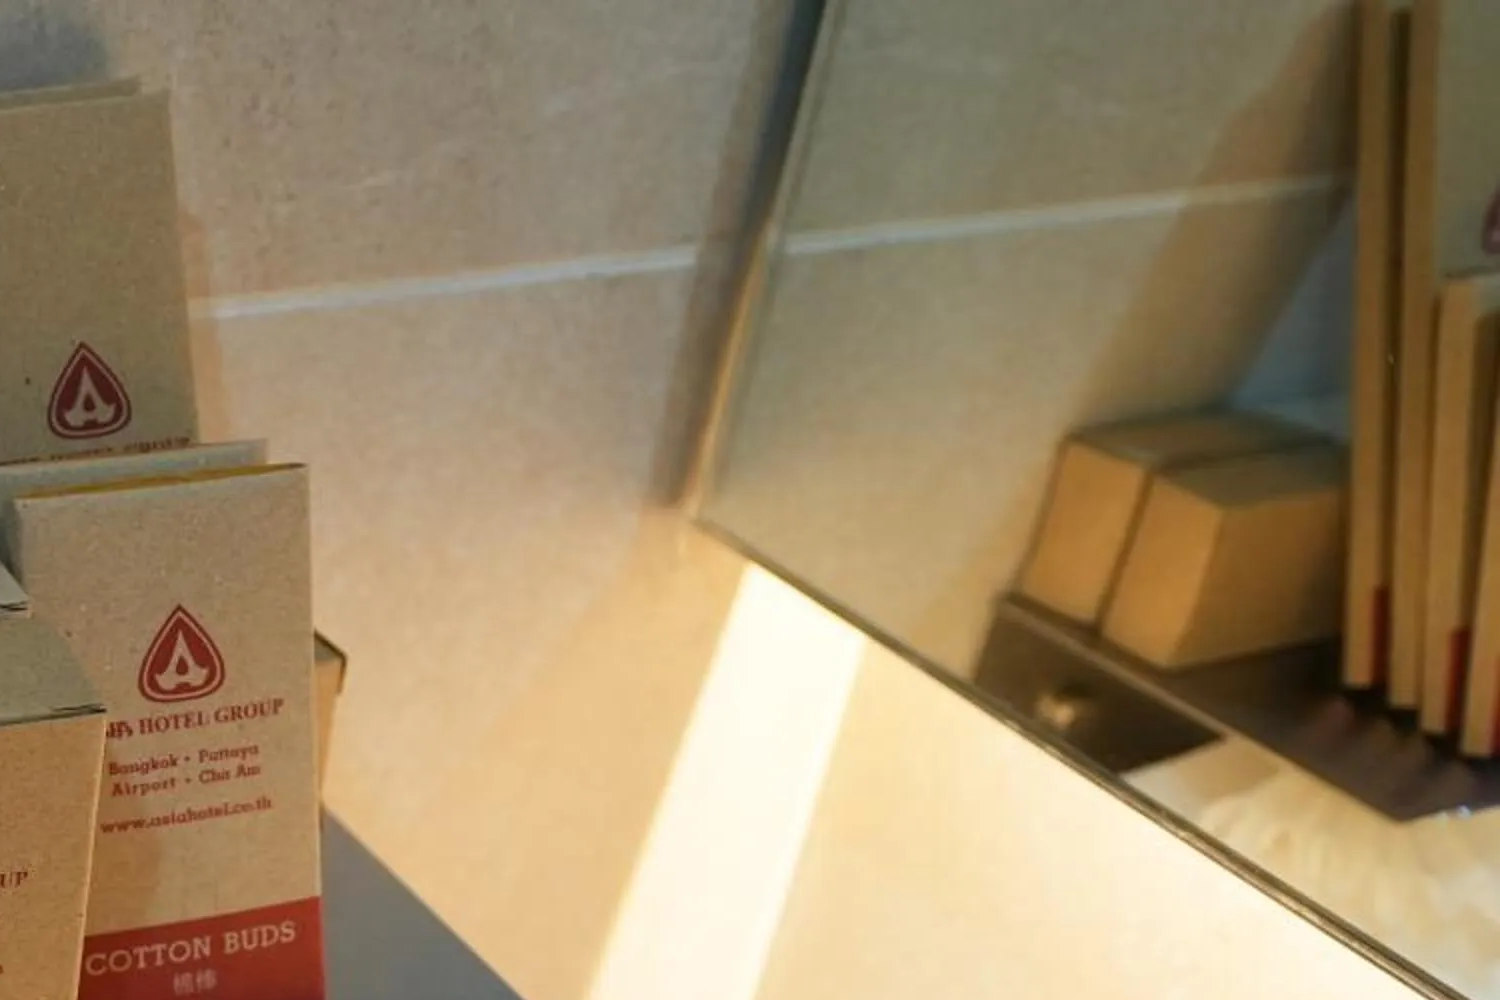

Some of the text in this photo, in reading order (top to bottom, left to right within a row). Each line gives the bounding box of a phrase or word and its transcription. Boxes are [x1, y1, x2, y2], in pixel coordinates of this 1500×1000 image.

[138, 709, 209, 736] HOTEL
[214, 698, 285, 726] GROUP
[108, 742, 260, 778] Bangkok Pattaya
[110, 762, 262, 798] Airport Cha Am
[101, 796, 273, 835] www.asiahotel.co.th
[84, 920, 296, 978] COTTON BUDS
